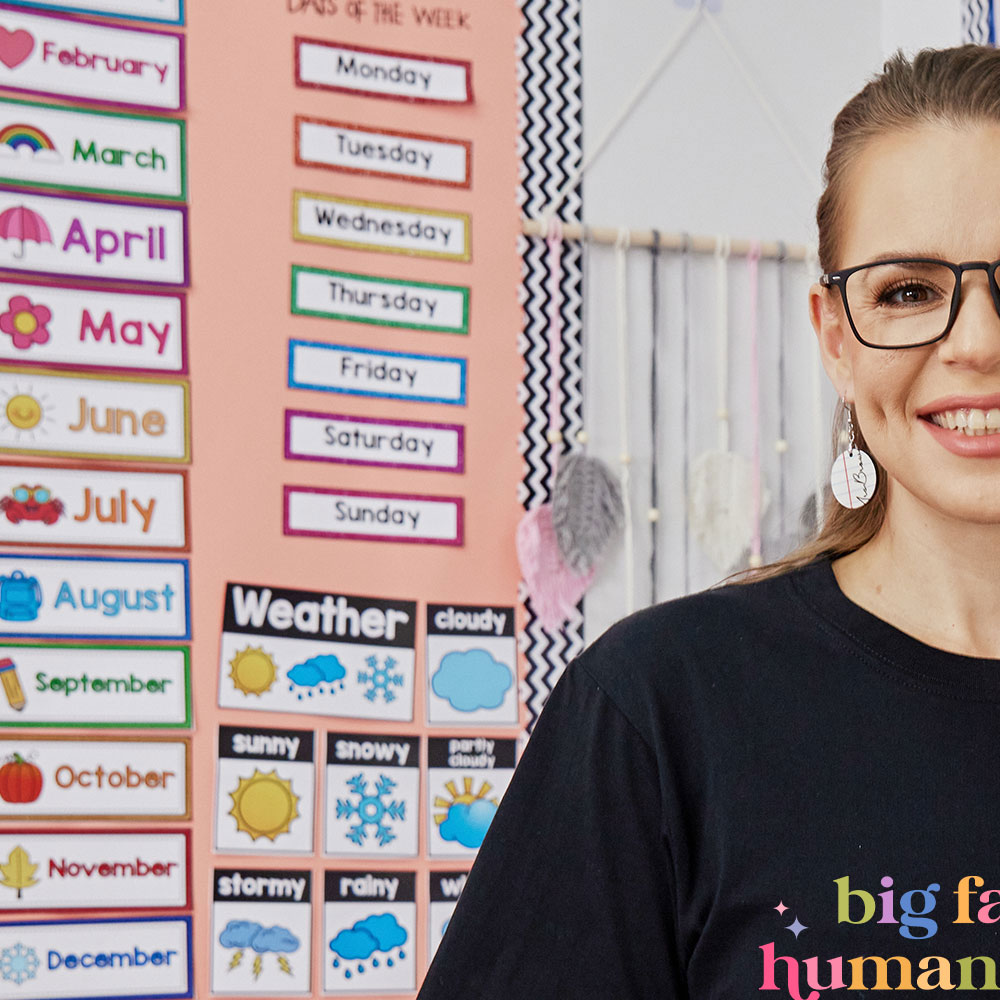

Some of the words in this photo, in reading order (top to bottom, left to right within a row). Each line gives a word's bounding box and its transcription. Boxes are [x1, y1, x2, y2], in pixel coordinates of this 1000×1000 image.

[346, 0, 366, 22] OF
[373, 3, 403, 25] THE
[412, 7, 471, 29] WEEK
[43, 41, 168, 84] February
[336, 55, 432, 90] Monday
[73, 139, 167, 171] March
[337, 135, 433, 170] Tuesday
[62, 217, 166, 264] April
[314, 207, 452, 245] Wednesday
[329, 281, 438, 317] Thursday
[79, 308, 171, 356] May
[340, 356, 417, 387] Friday
[69, 397, 166, 437] June
[324, 424, 434, 456] Saturday
[74, 487, 156, 534] July
[334, 501, 421, 528] Sunday
[54, 581, 175, 617] August
[232, 586, 409, 641] Weather
[434, 607, 507, 634] cloudy
[36, 672, 172, 697] September
[232, 732, 300, 760] sunny
[335, 737, 411, 766] snowy
[448, 753, 496, 769] cloudy
[449, 738, 495, 754] partly
[55, 765, 175, 789] October
[49, 857, 177, 878] November
[218, 873, 306, 901] stormy
[339, 873, 399, 899] rainy
[833, 876, 941, 939] big
[48, 946, 177, 971] December
